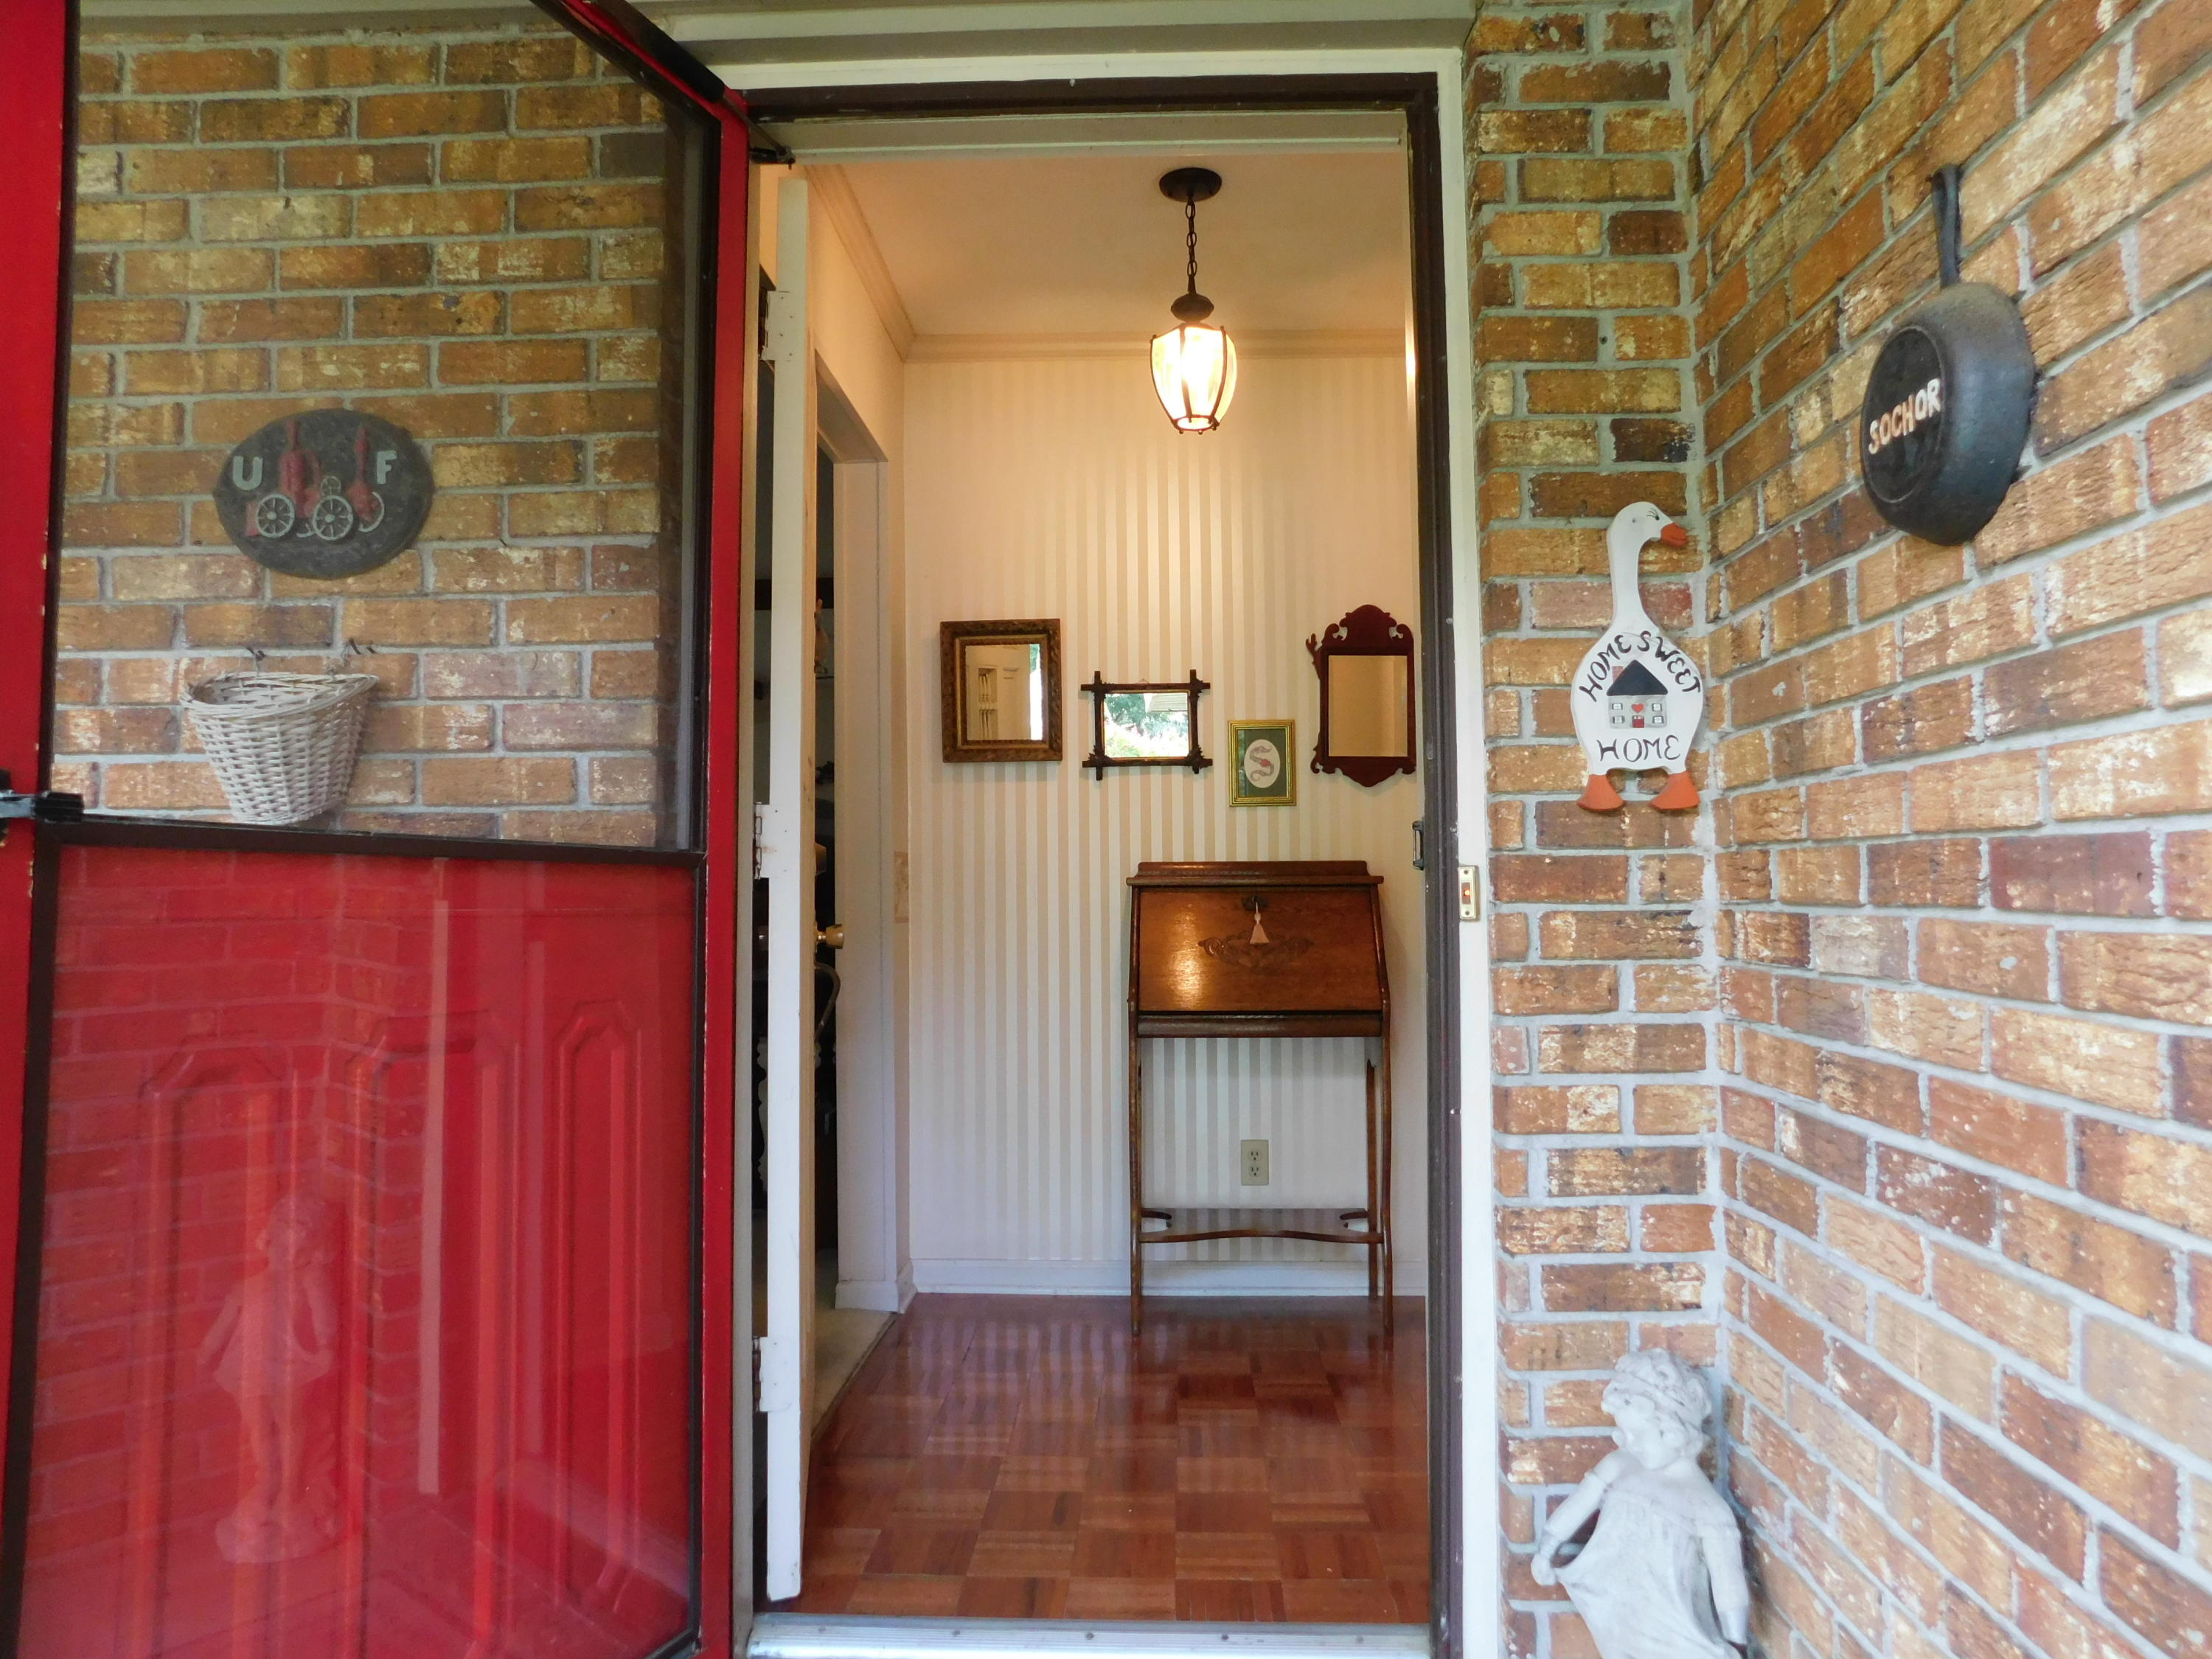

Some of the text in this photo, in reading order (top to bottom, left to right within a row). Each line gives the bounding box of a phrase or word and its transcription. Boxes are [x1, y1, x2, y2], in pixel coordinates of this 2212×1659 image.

[1868, 378, 1941, 455] SOCHOR
[1579, 630, 1701, 703] HOME SWEET
[1596, 734, 1680, 762] HOME
